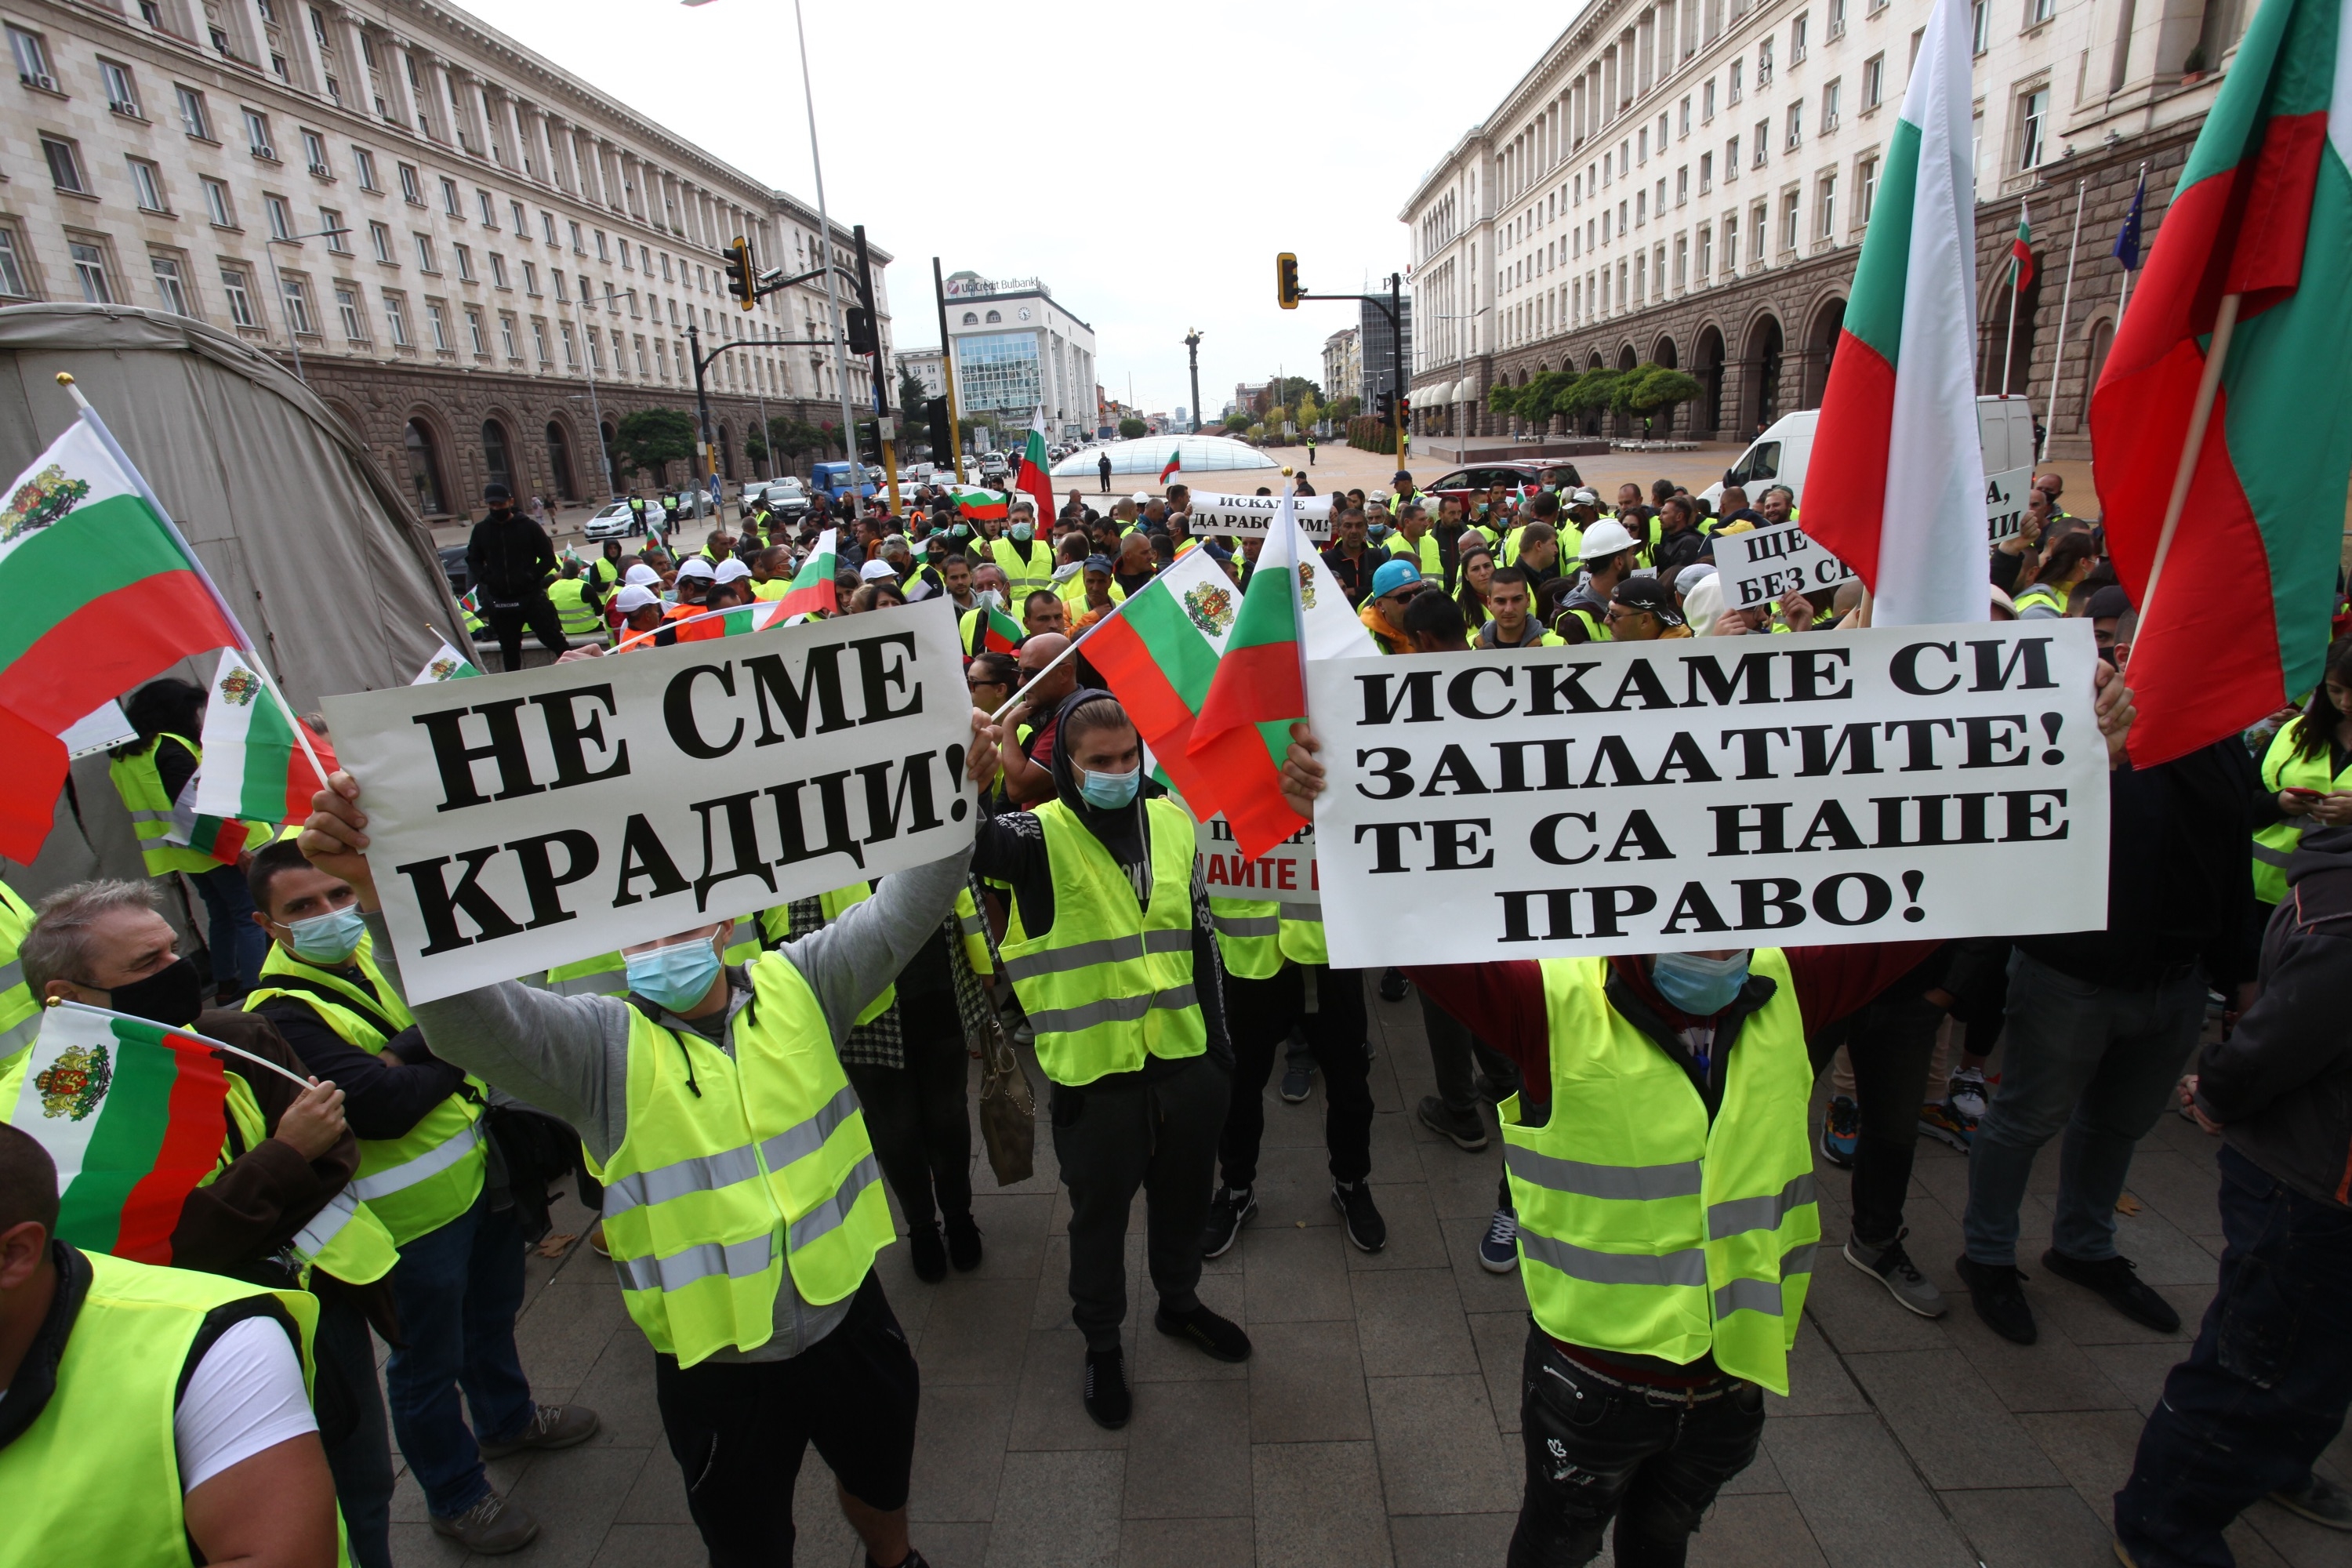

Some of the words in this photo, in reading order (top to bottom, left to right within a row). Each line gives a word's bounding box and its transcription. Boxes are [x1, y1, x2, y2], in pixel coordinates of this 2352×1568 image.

[962, 280, 1000, 293] UniCredit
[1001, 277, 1037, 289] Bulbank
[1192, 513, 1218, 529] ДА
[1225, 514, 1329, 532] РАБОМ!
[1744, 528, 1808, 563] ЩЕ
[1737, 567, 1806, 604] БЕЗ
[1355, 648, 1853, 725] ИСКАМЕ
[1889, 637, 2059, 695] СИ
[412, 683, 630, 812] НЕ
[663, 631, 923, 759] СМЕ
[1356, 713, 2064, 800] ЗАПЛАТИТЕ!
[396, 743, 968, 956] КРАДЦИ!
[1355, 818, 1494, 873] ТЕ
[1530, 810, 1676, 865] СА
[1707, 789, 2069, 856] НАШЕ
[1198, 848, 1297, 890] АЙТЕ
[1495, 870, 1925, 942] ПРАВО!
